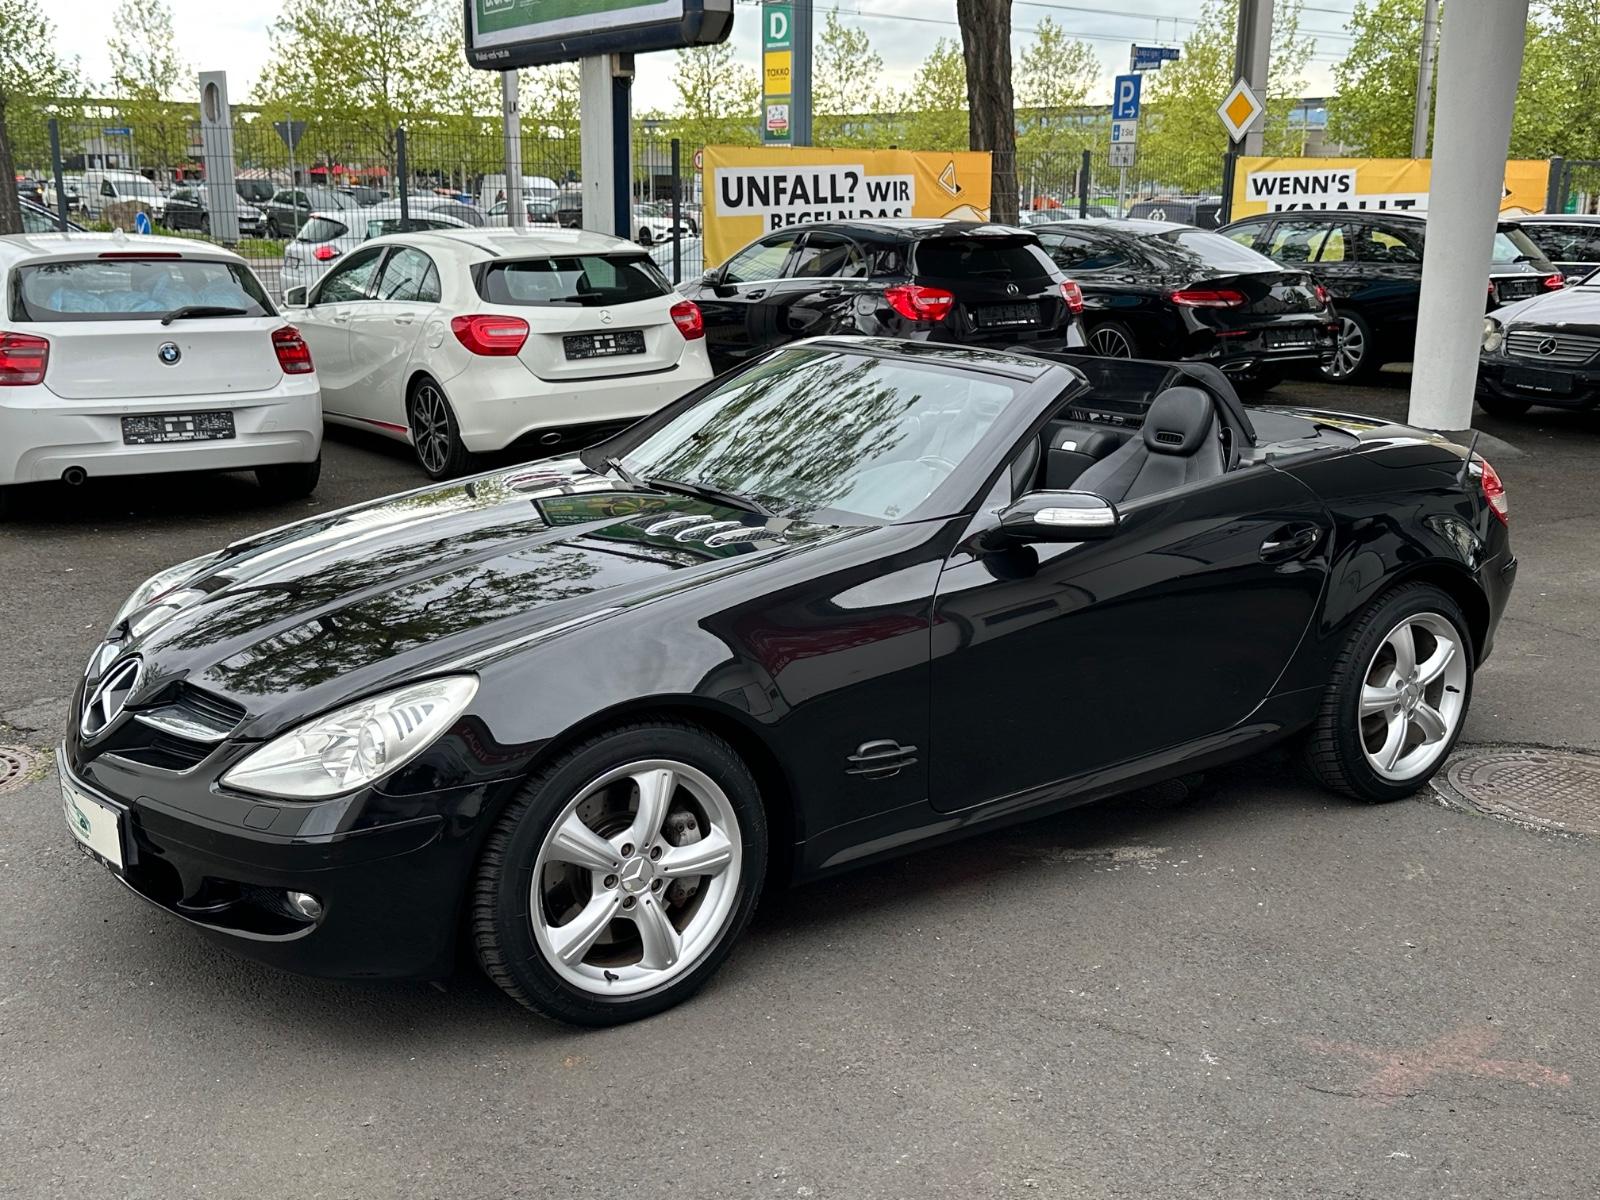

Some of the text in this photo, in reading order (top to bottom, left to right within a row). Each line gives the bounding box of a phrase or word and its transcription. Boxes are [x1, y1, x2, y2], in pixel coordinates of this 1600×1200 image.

[770, 12, 787, 39] D
[1118, 80, 1135, 117] P
[721, 171, 910, 208] UNFALL? WIR
[1252, 174, 1350, 196] WENN'S
